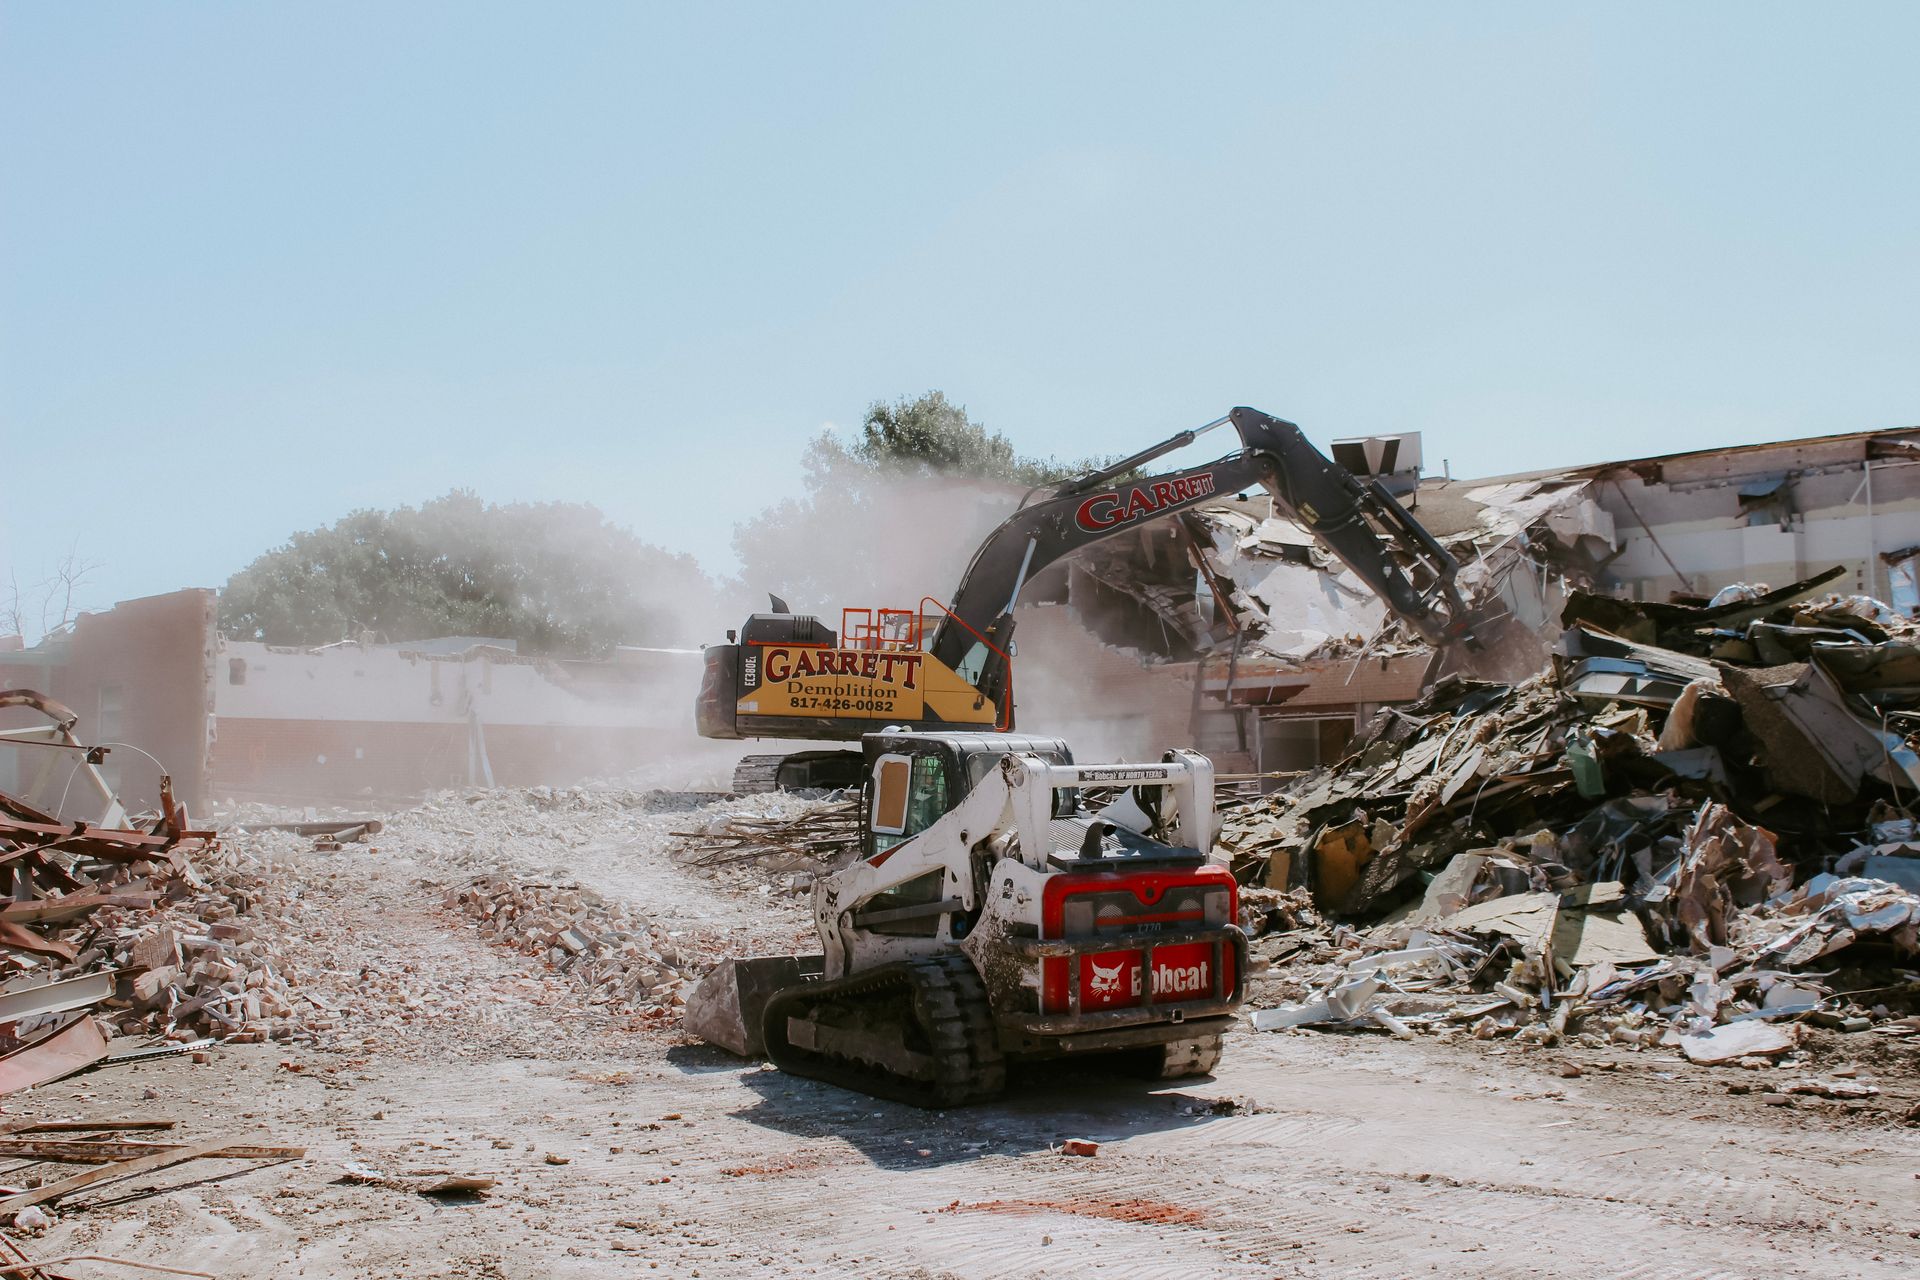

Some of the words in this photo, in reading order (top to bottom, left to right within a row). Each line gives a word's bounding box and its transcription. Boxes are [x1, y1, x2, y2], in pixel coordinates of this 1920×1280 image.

[1075, 472, 1215, 533] GARRETT
[764, 648, 923, 691] GARRETT
[787, 681, 898, 699] Demolition
[790, 697, 894, 712] 817-426-0082
[1146, 770, 1163, 779] TEXAS
